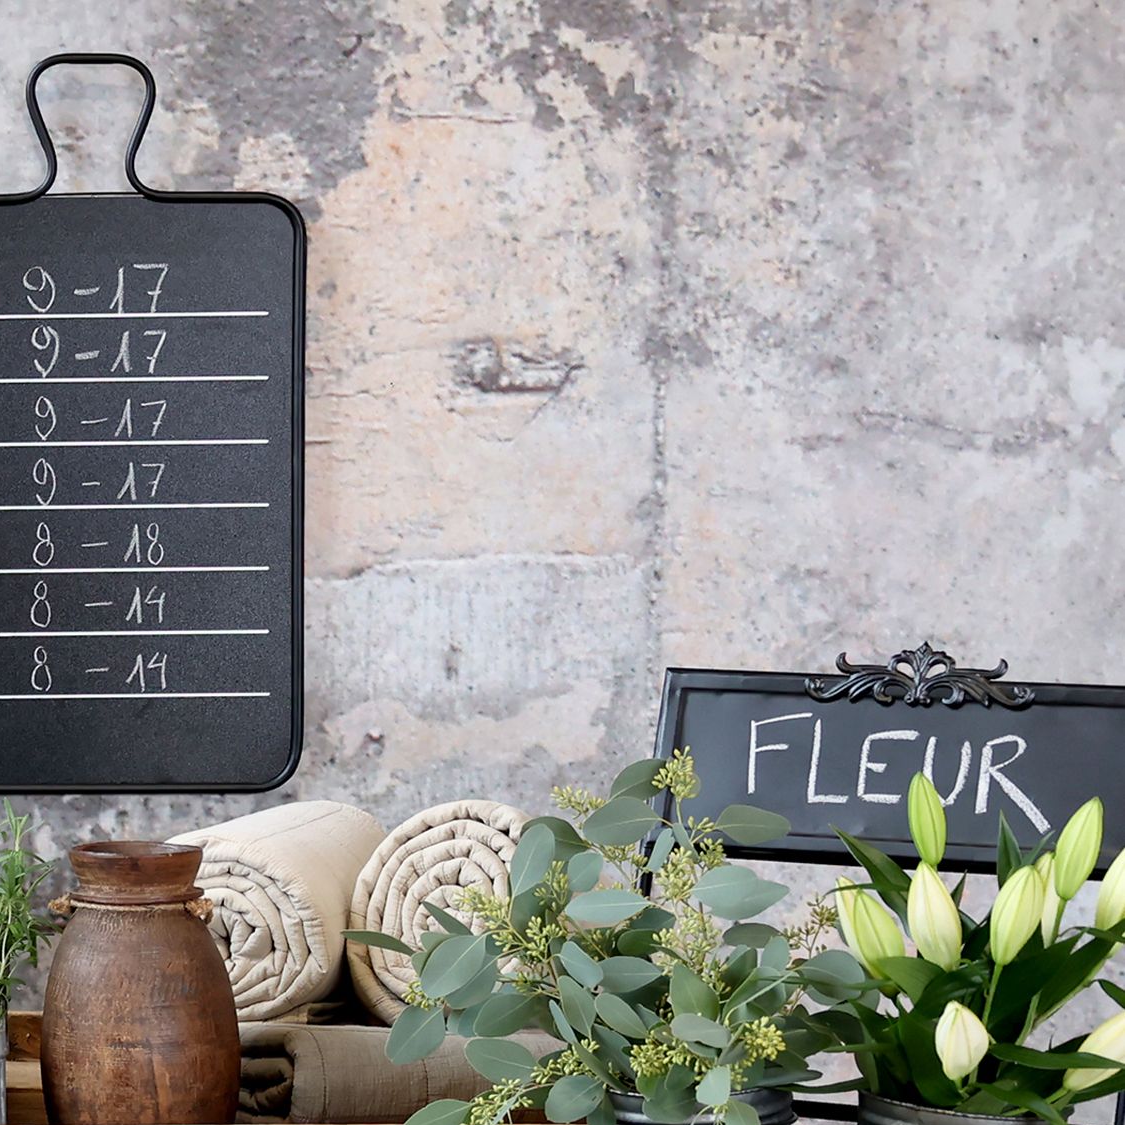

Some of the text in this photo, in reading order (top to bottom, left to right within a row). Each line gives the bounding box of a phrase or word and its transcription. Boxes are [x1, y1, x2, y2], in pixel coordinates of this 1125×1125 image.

[22, 266, 56, 313] 9
[109, 263, 169, 313] 17
[31, 325, 60, 378] 9
[110, 330, 167, 374] 17
[35, 396, 57, 441] 9
[114, 399, 167, 438] 17
[32, 458, 57, 506] 9
[117, 462, 165, 501] 17
[32, 522, 55, 566] 8
[124, 522, 164, 566] 18
[30, 580, 52, 628] 8
[125, 585, 166, 624] 14
[30, 646, 52, 692] 8
[125, 652, 168, 692] 14
[747, 712, 1053, 835] FLEUR
